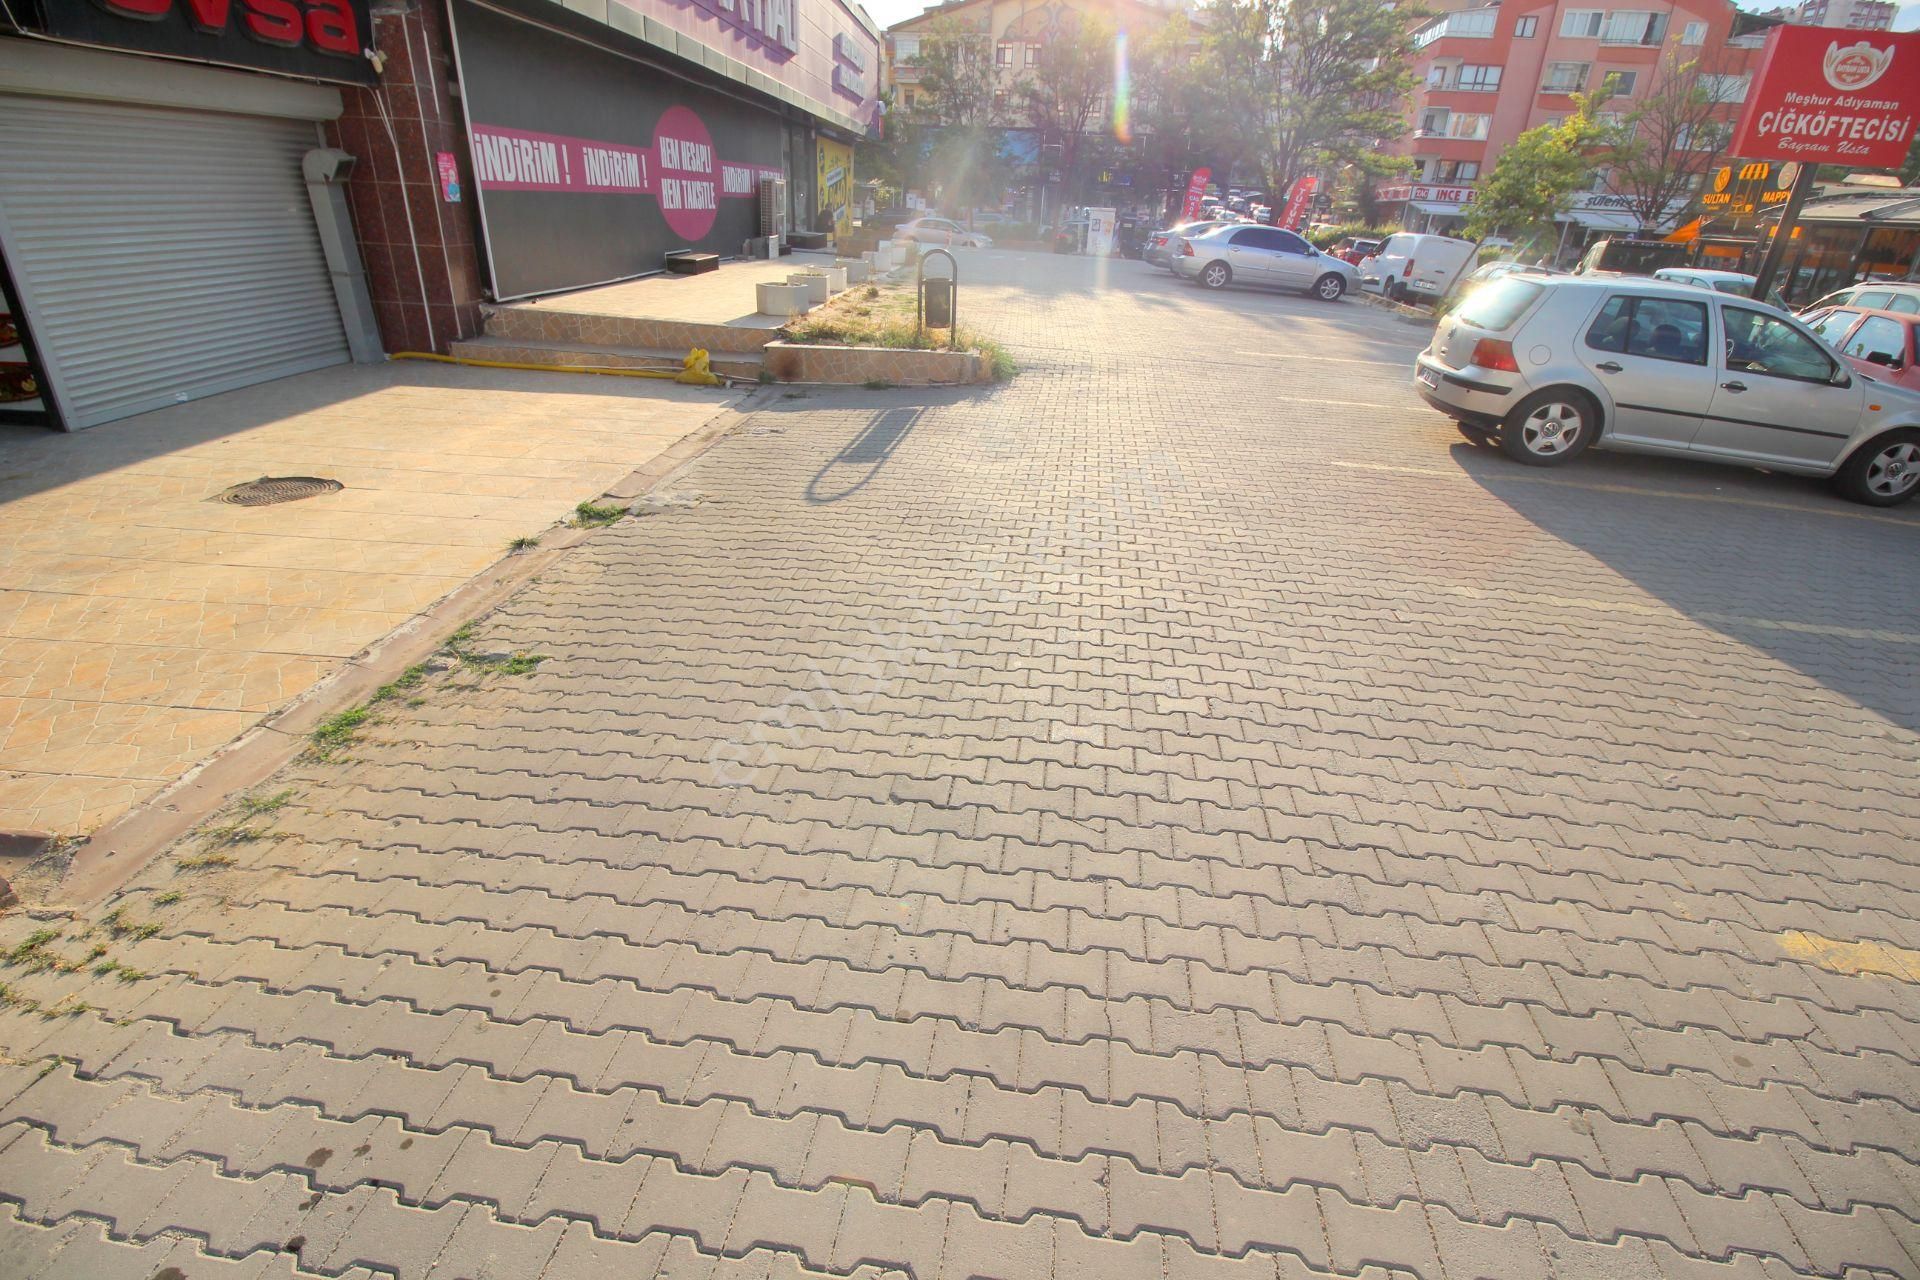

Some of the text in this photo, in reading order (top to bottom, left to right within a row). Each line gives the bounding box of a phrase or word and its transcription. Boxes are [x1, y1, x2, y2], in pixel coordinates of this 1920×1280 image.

[1784, 92, 1899, 111] Meşhur Adıyaman
[1758, 106, 1911, 142] ÇİĞKÖFTECİSİ
[659, 136, 712, 173] HEM HESAPLI
[1777, 137, 1871, 155] Bayram Usta
[661, 178, 682, 209] HEM
[1702, 193, 1731, 204] SULTAN
